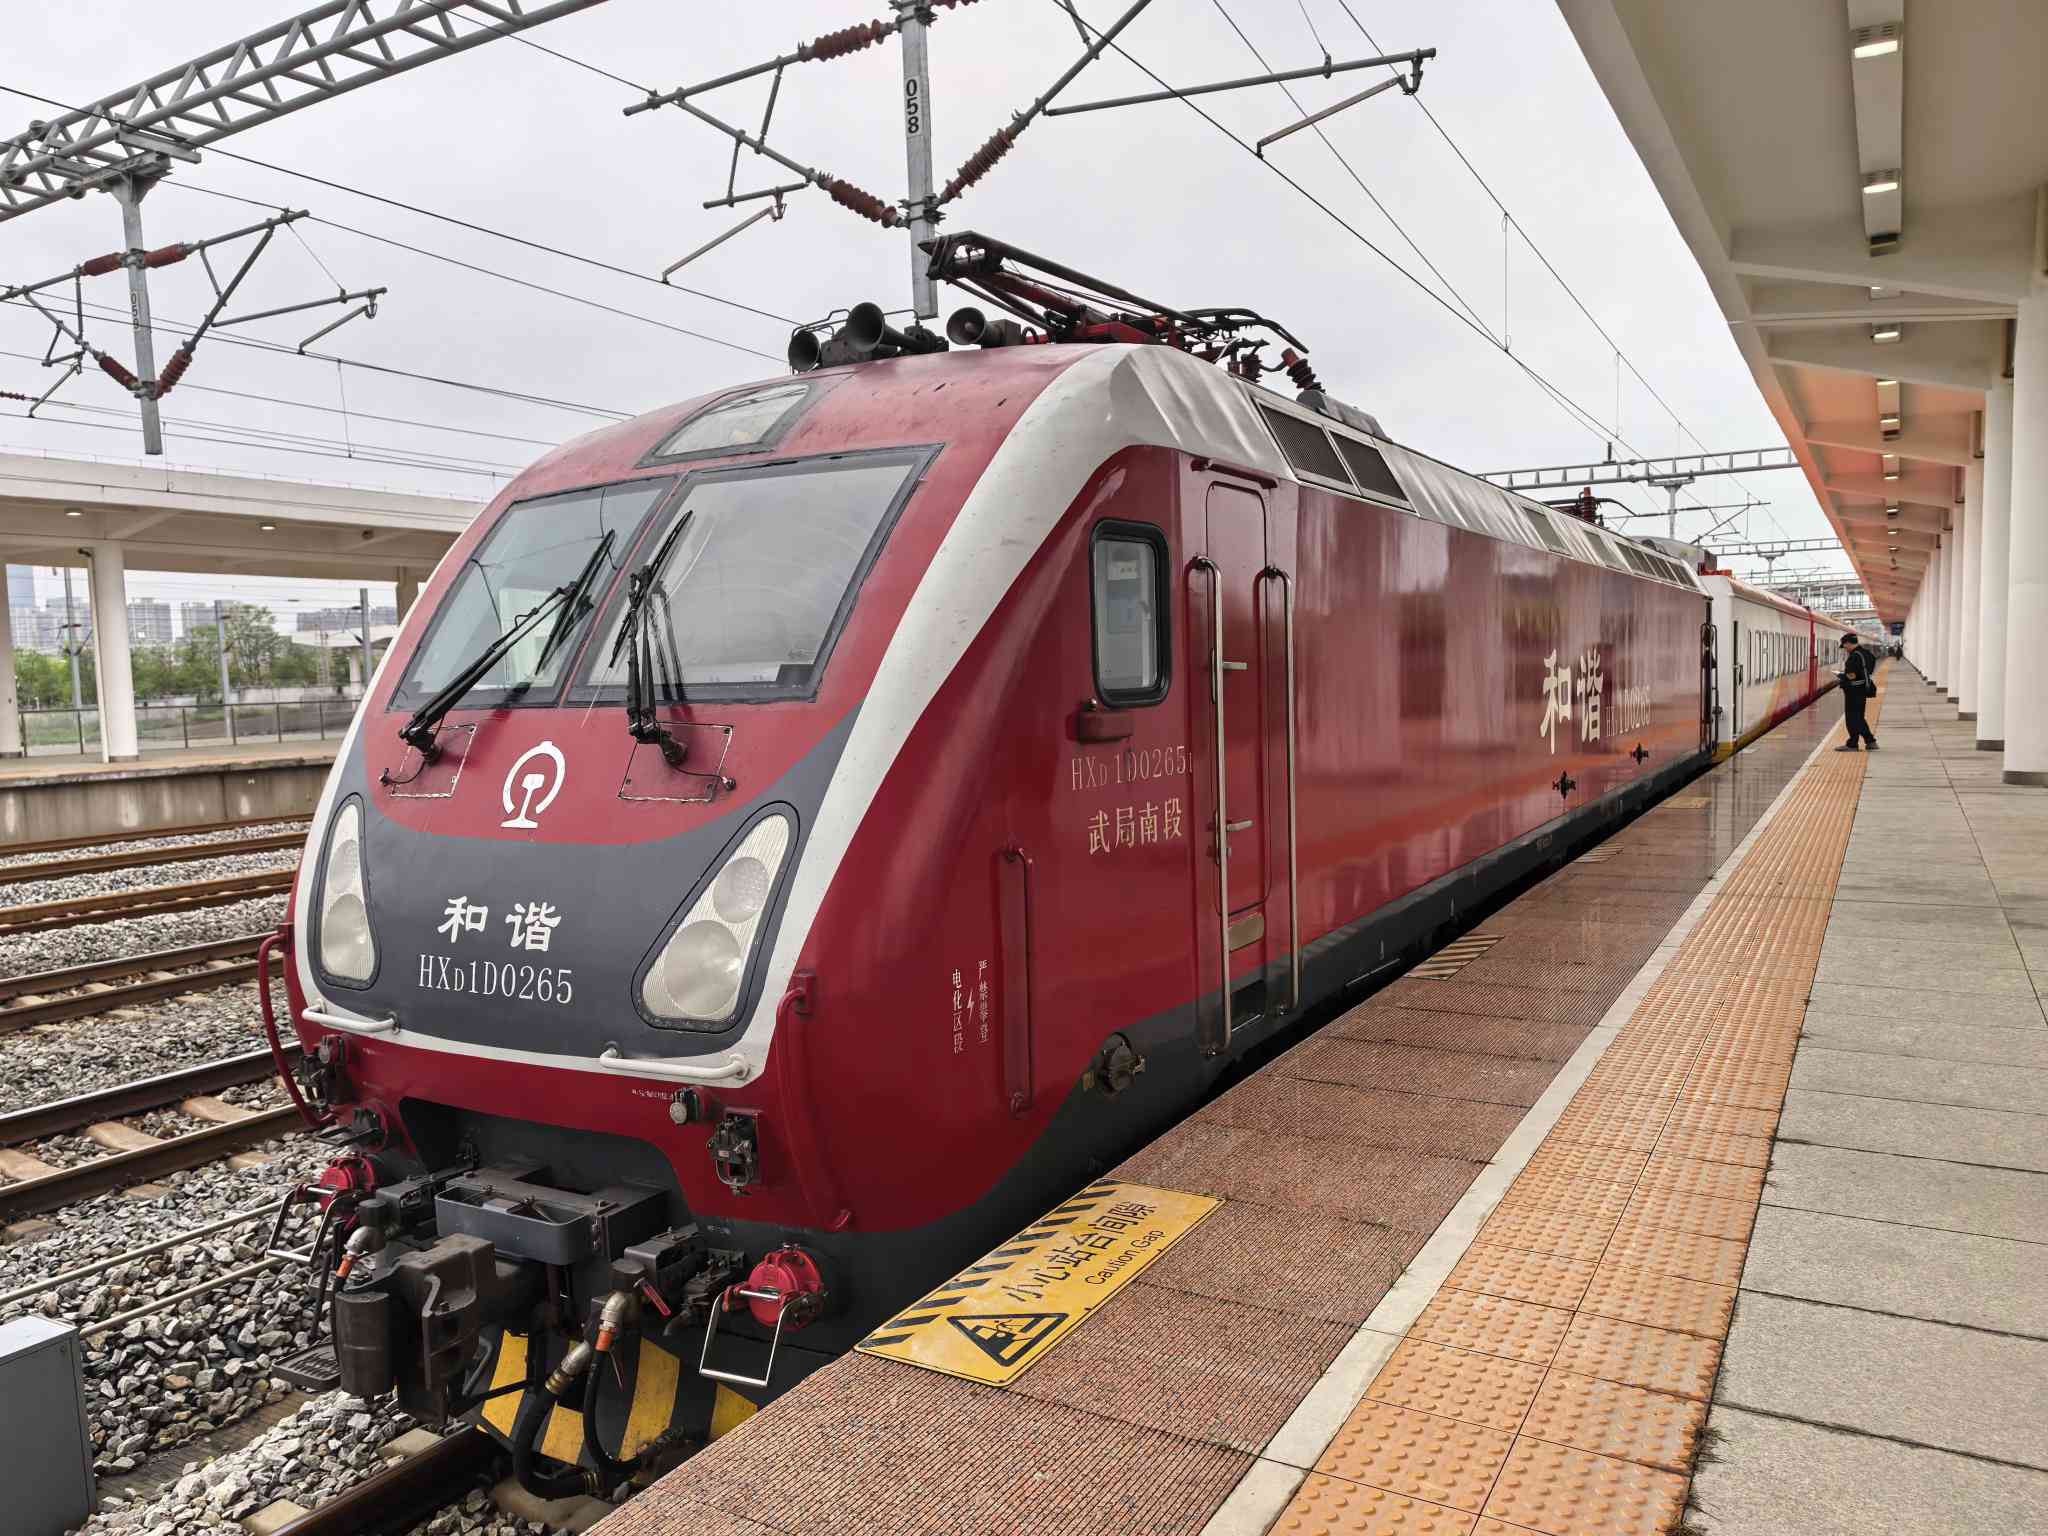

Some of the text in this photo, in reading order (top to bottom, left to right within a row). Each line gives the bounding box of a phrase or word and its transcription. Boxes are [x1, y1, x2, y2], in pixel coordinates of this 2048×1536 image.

[906, 78, 919, 134] 058
[1540, 648, 1604, 755] 和谐
[1087, 797, 1183, 855] 武局南段
[437, 895, 562, 952] 和谐
[1001, 1200, 1158, 1303] 小心站台间隙
[1084, 1229, 1165, 1286] Caution Gap
